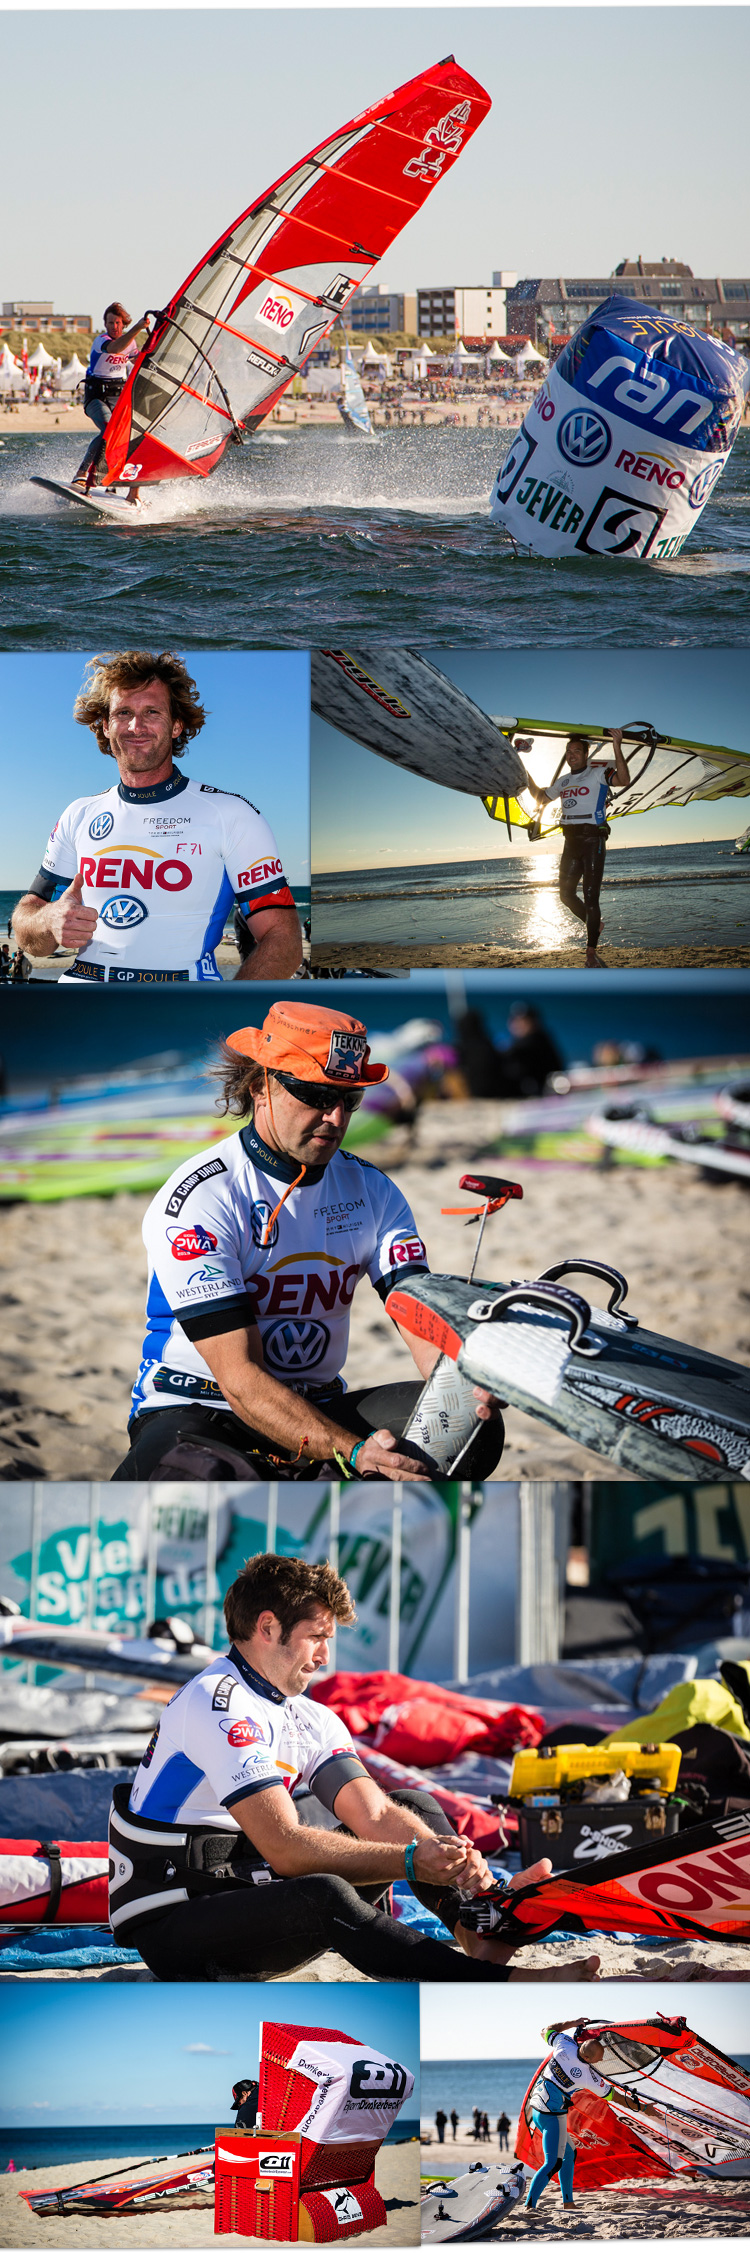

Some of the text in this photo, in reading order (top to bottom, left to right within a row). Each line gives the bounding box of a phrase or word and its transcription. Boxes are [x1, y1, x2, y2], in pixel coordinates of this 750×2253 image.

[260, 297, 294, 328] RENO
[587, 355, 715, 435] ran
[615, 449, 686, 489] RENO
[516, 477, 585, 534] JEVER
[143, 817, 191, 825] FREEDOM
[80, 856, 193, 892] RENO
[237, 858, 284, 888] RENO
[74, 963, 98, 978] JOULE
[117, 971, 180, 983] GP JOULE
[249, 1138, 259, 1149] GP
[176, 1160, 224, 1196] CAMP DAVID
[313, 1198, 366, 1218] FREEDOM
[326, 1213, 350, 1224] SPORT
[176, 1238, 212, 1251] PWA
[176, 1277, 242, 1300] WESTERLAND
[204, 1291, 220, 1299] SYLT
[247, 1263, 360, 1316] RENO
[168, 1374, 198, 1388] GP
[56, 1528, 144, 1581] Viel
[232, 1727, 263, 1740] PWA
